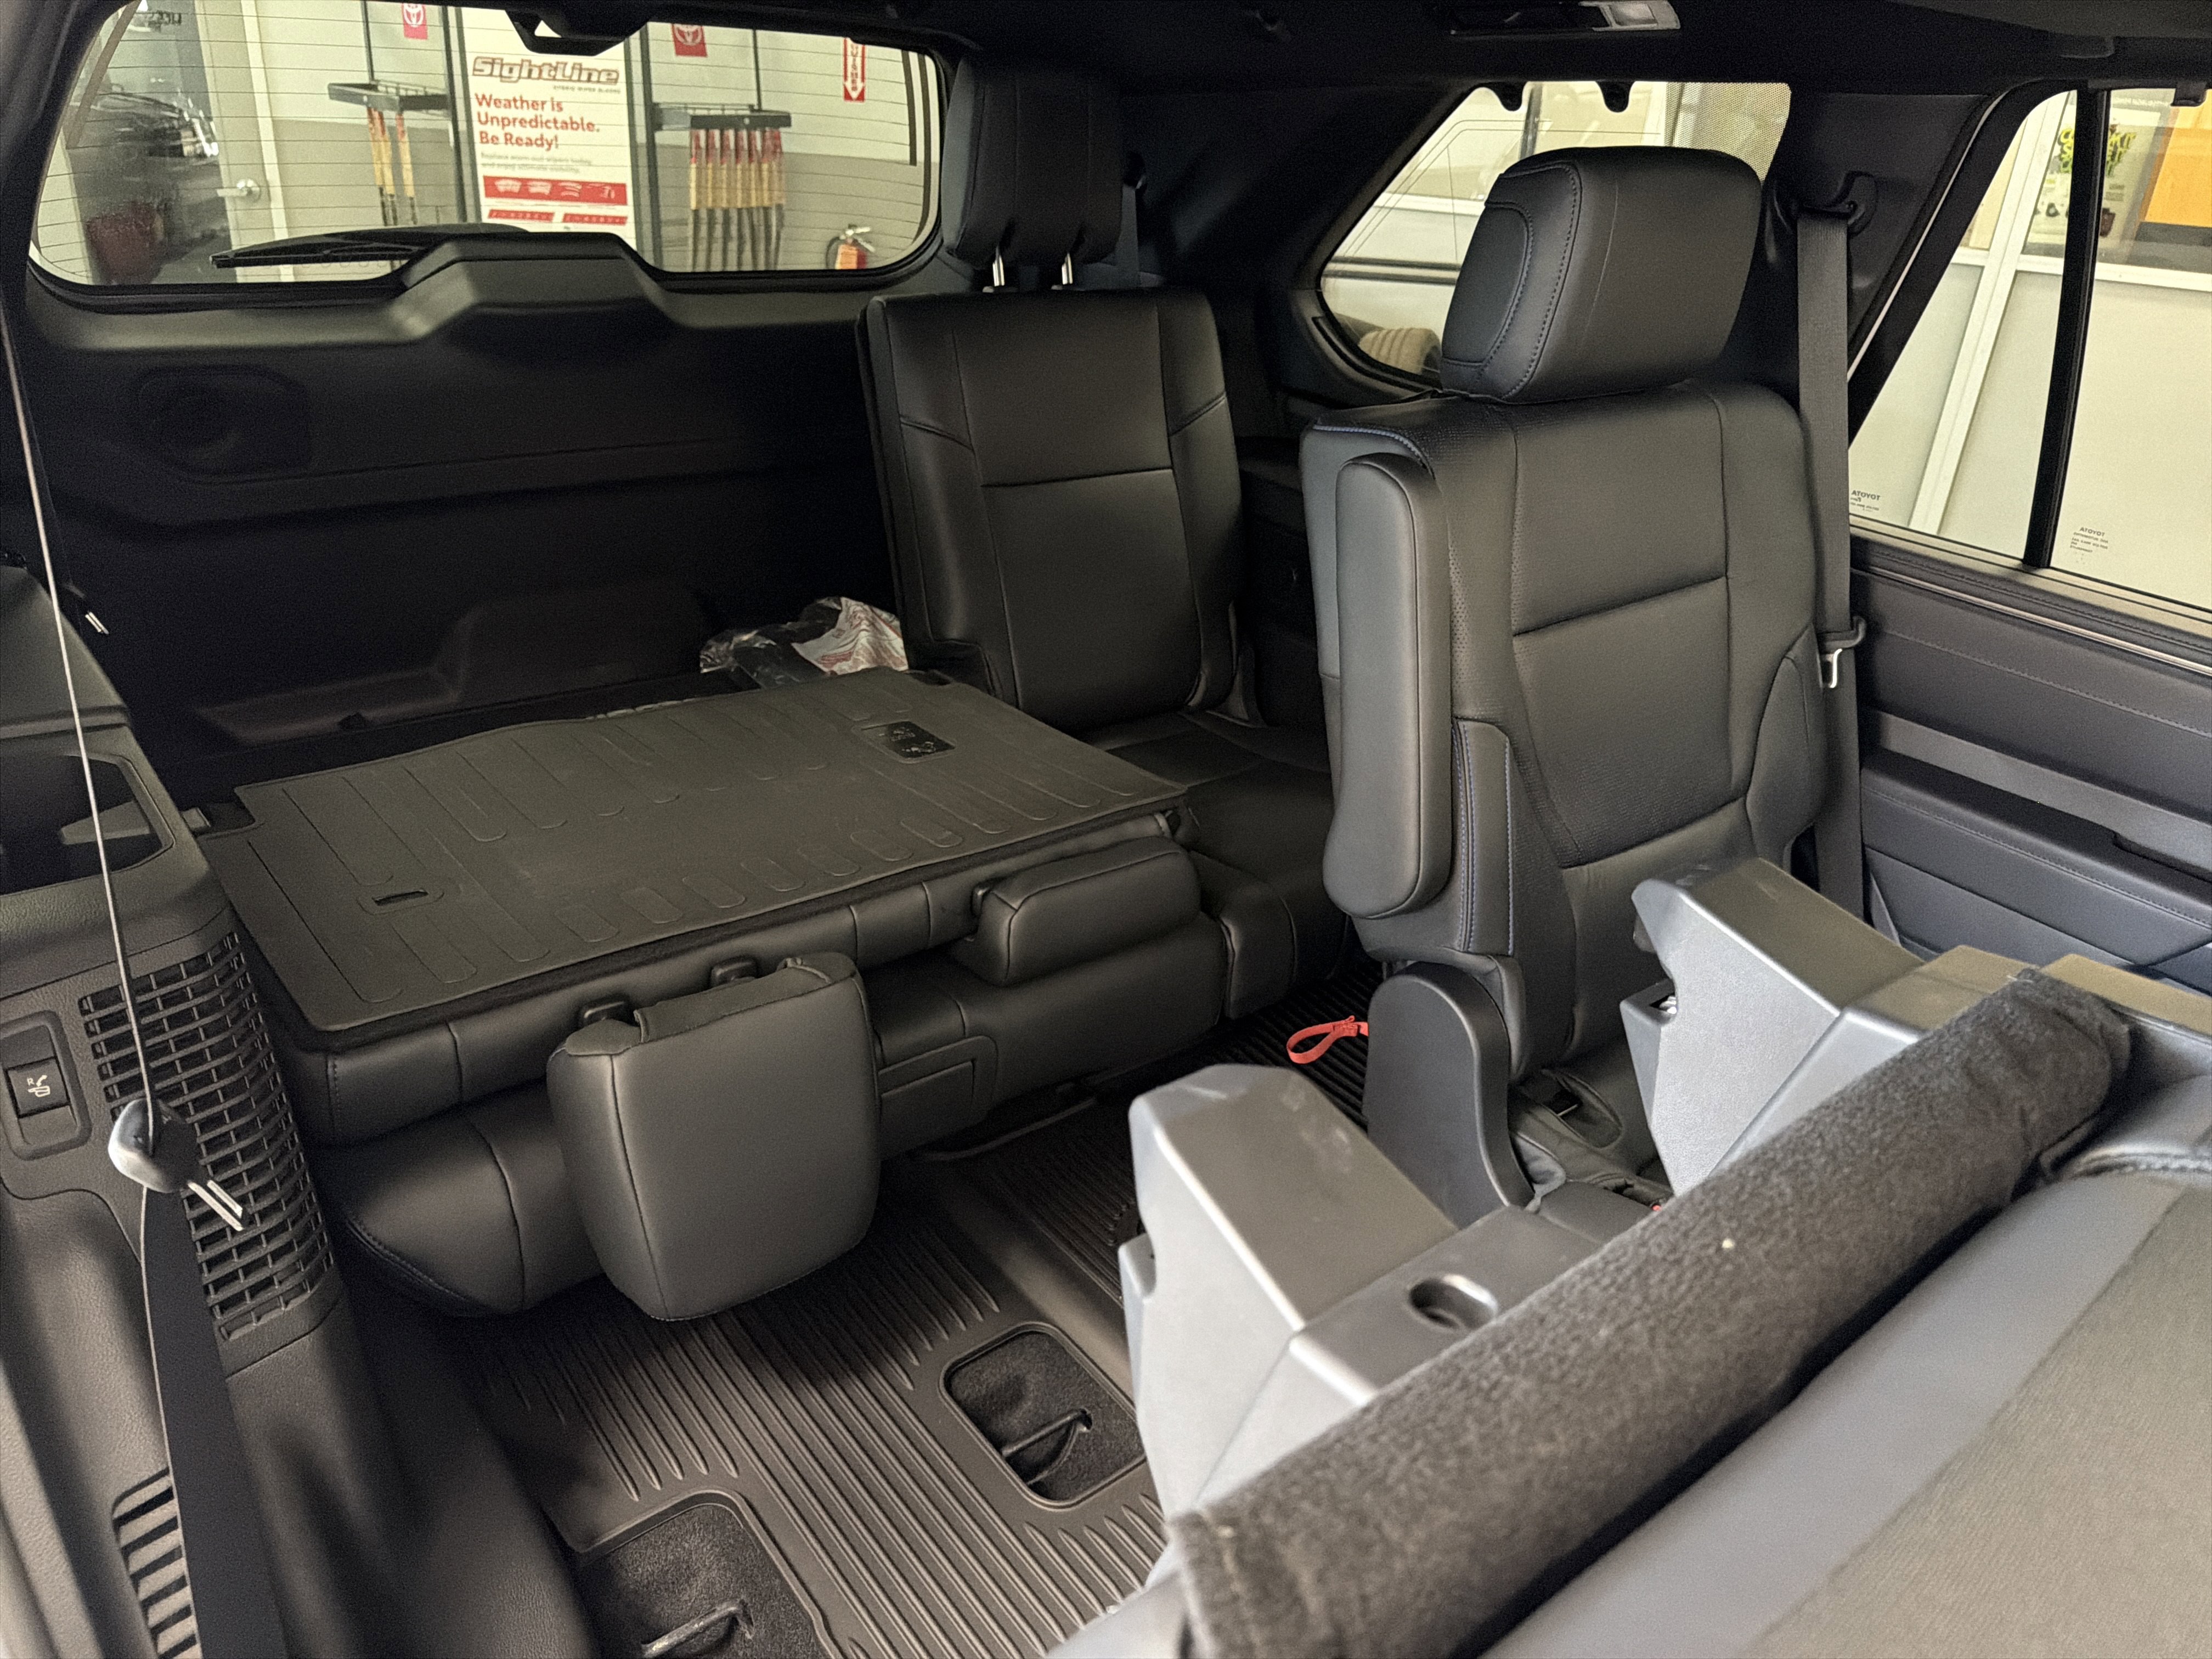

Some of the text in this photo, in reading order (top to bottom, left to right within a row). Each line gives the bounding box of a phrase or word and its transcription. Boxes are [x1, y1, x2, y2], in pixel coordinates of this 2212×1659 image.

[472, 56, 619, 86] SightLine
[475, 93, 563, 112] Weather is
[477, 111, 600, 132] Unpredictable.
[479, 131, 558, 151] Be Ready!
[26, 1077, 35, 1086] R
